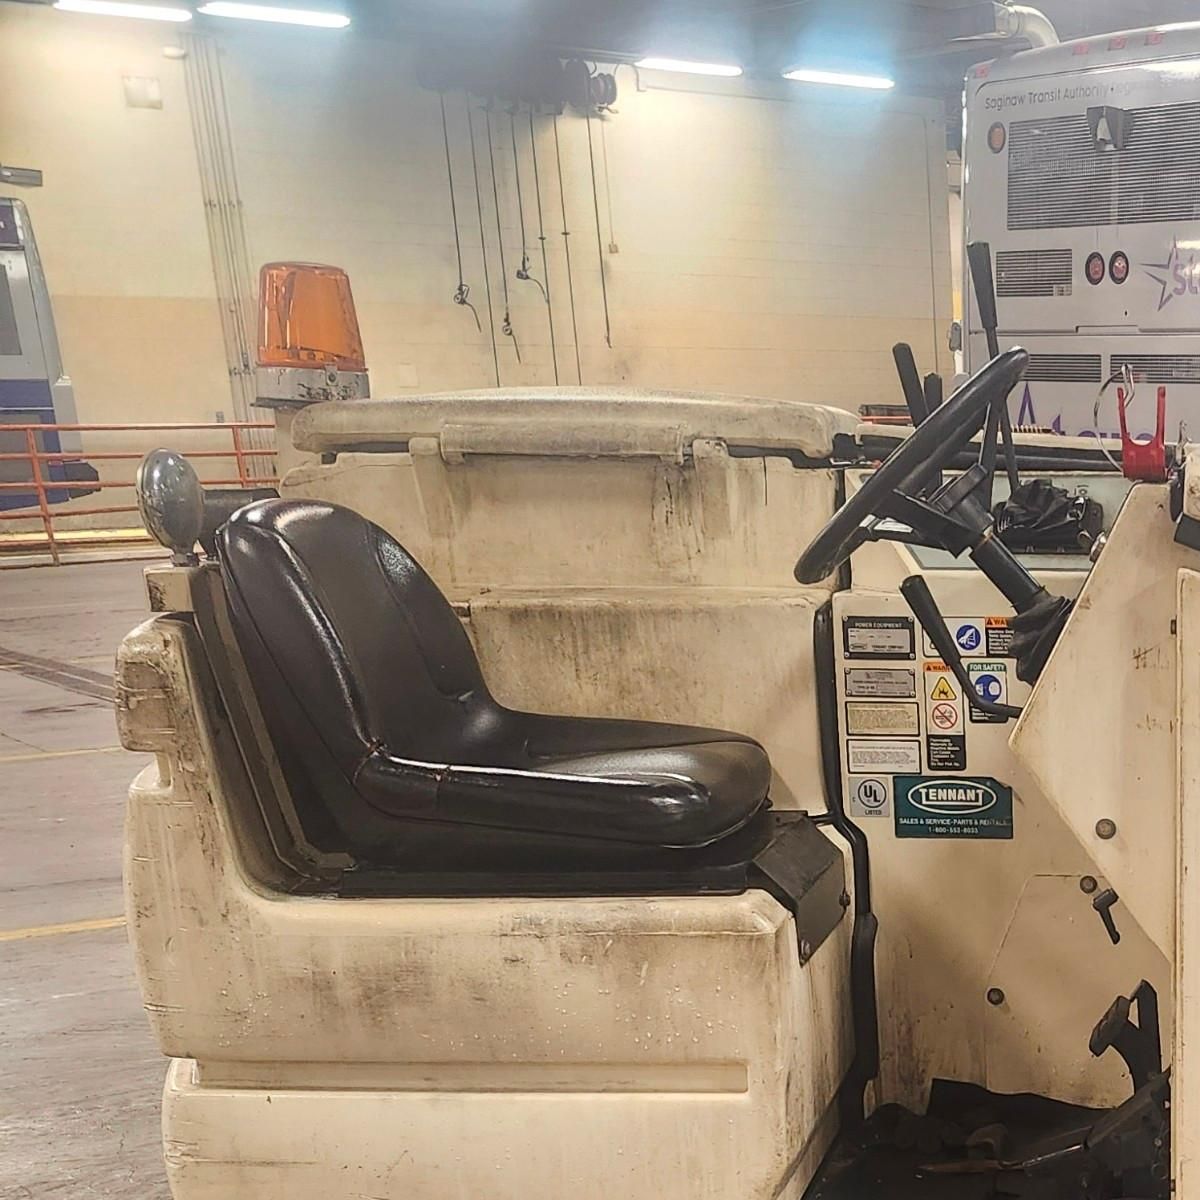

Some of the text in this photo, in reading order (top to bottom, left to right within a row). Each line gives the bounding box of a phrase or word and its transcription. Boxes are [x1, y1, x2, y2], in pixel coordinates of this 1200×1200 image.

[985, 95, 1025, 112] Saginaw
[1028, 88, 1060, 103] Transit
[969, 663, 1005, 671] FOR SAFETY
[863, 785, 881, 803] UL
[918, 788, 984, 806] TENNANT
[899, 817, 918, 825] SALES
